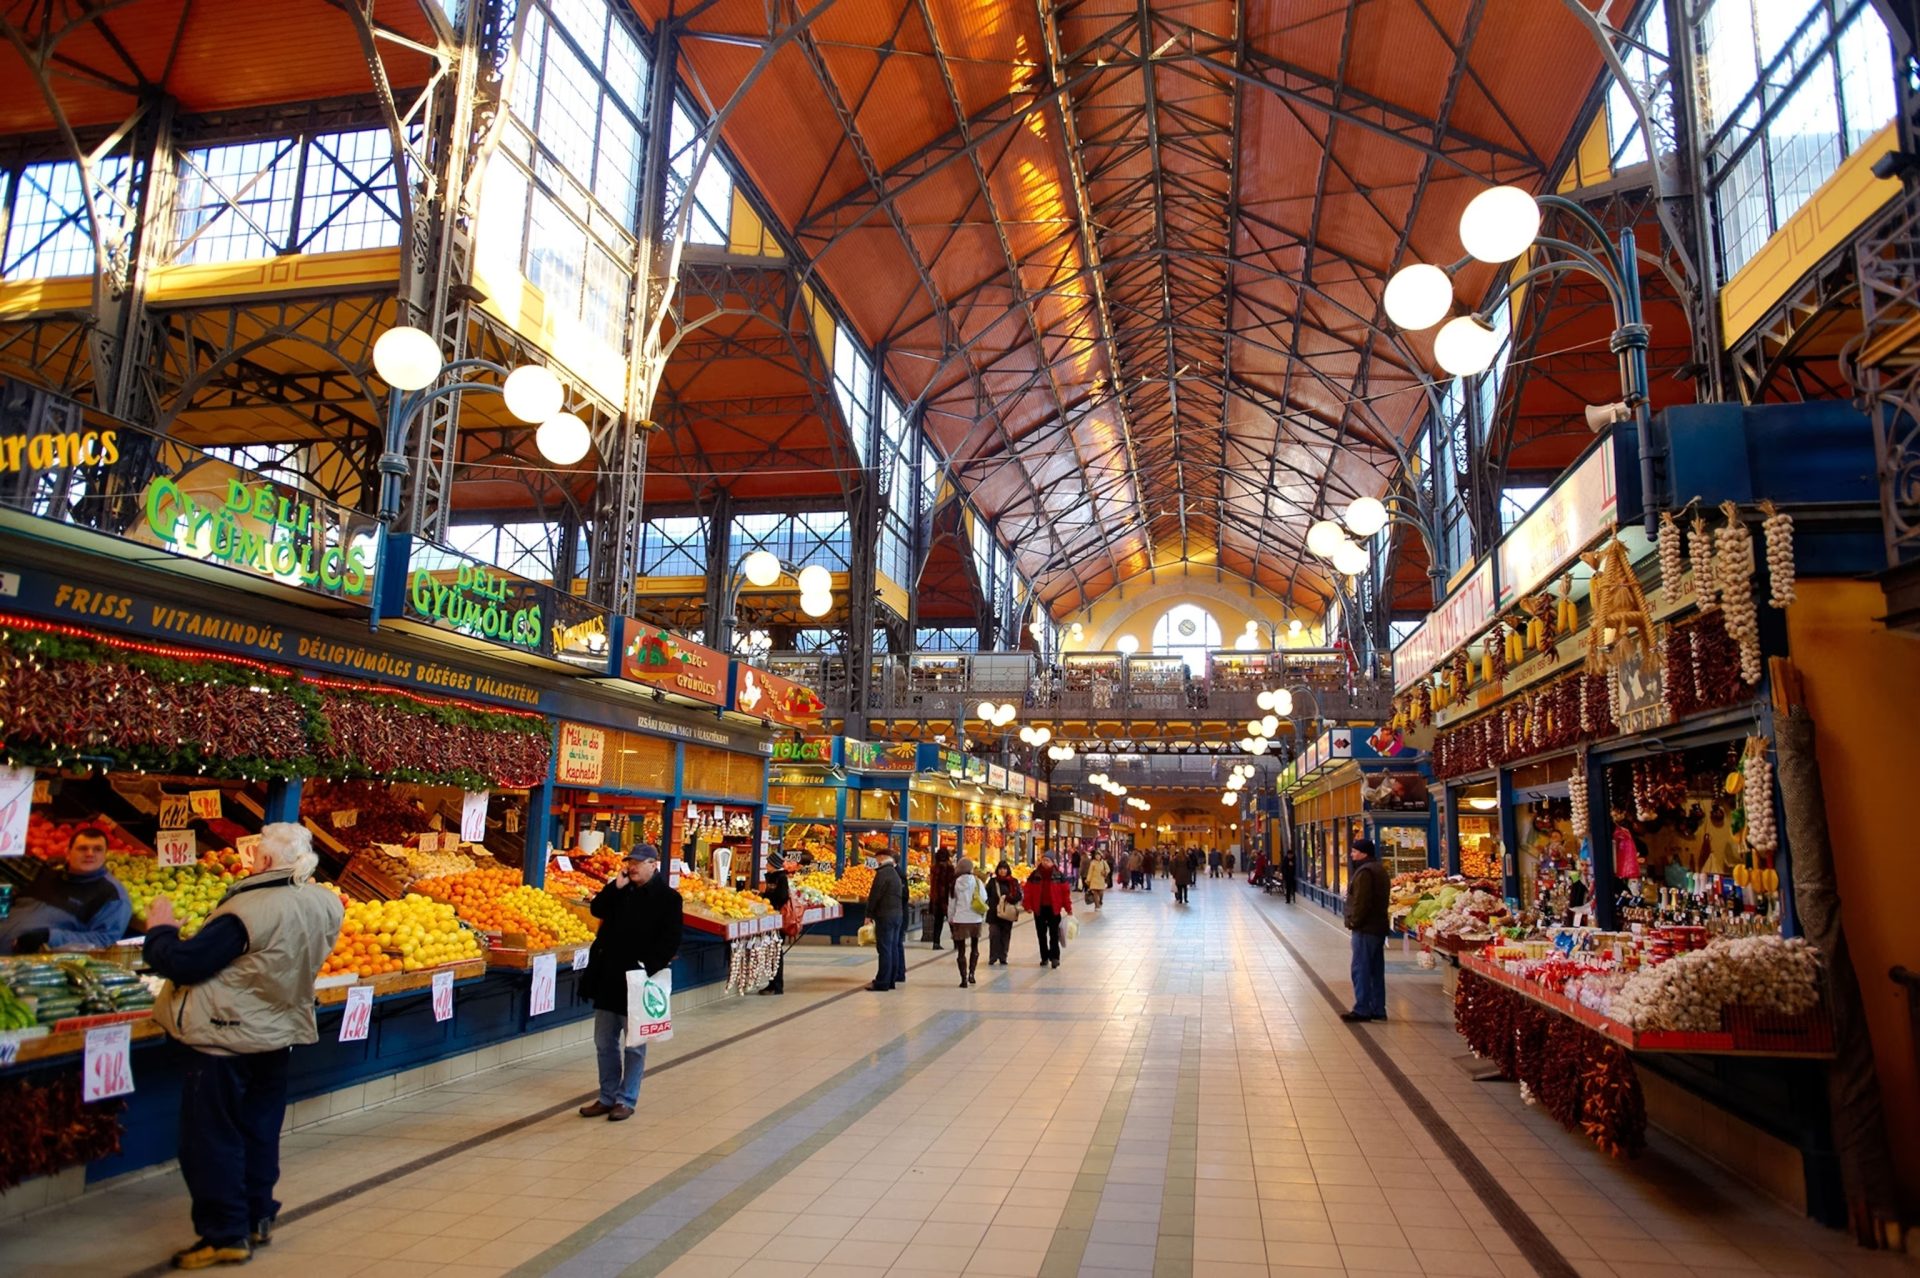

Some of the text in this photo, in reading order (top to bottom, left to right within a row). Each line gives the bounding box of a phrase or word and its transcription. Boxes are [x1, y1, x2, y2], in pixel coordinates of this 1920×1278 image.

[225, 478, 322, 536] DÉLI-
[146, 476, 366, 596] GYÜMÖLCS
[456, 563, 515, 602] DÉLI-
[411, 567, 542, 648] GYÜMÖLCS
[54, 584, 539, 705] FRISS, VITAMINDÚS, DÉLIGYÜMÖLCS BŐSÉGES VÁLASZTÉKA
[677, 672, 716, 696] GYÜMÖLCS
[566, 759, 599, 780] kapható!
[641, 1022, 671, 1035] SPAR
